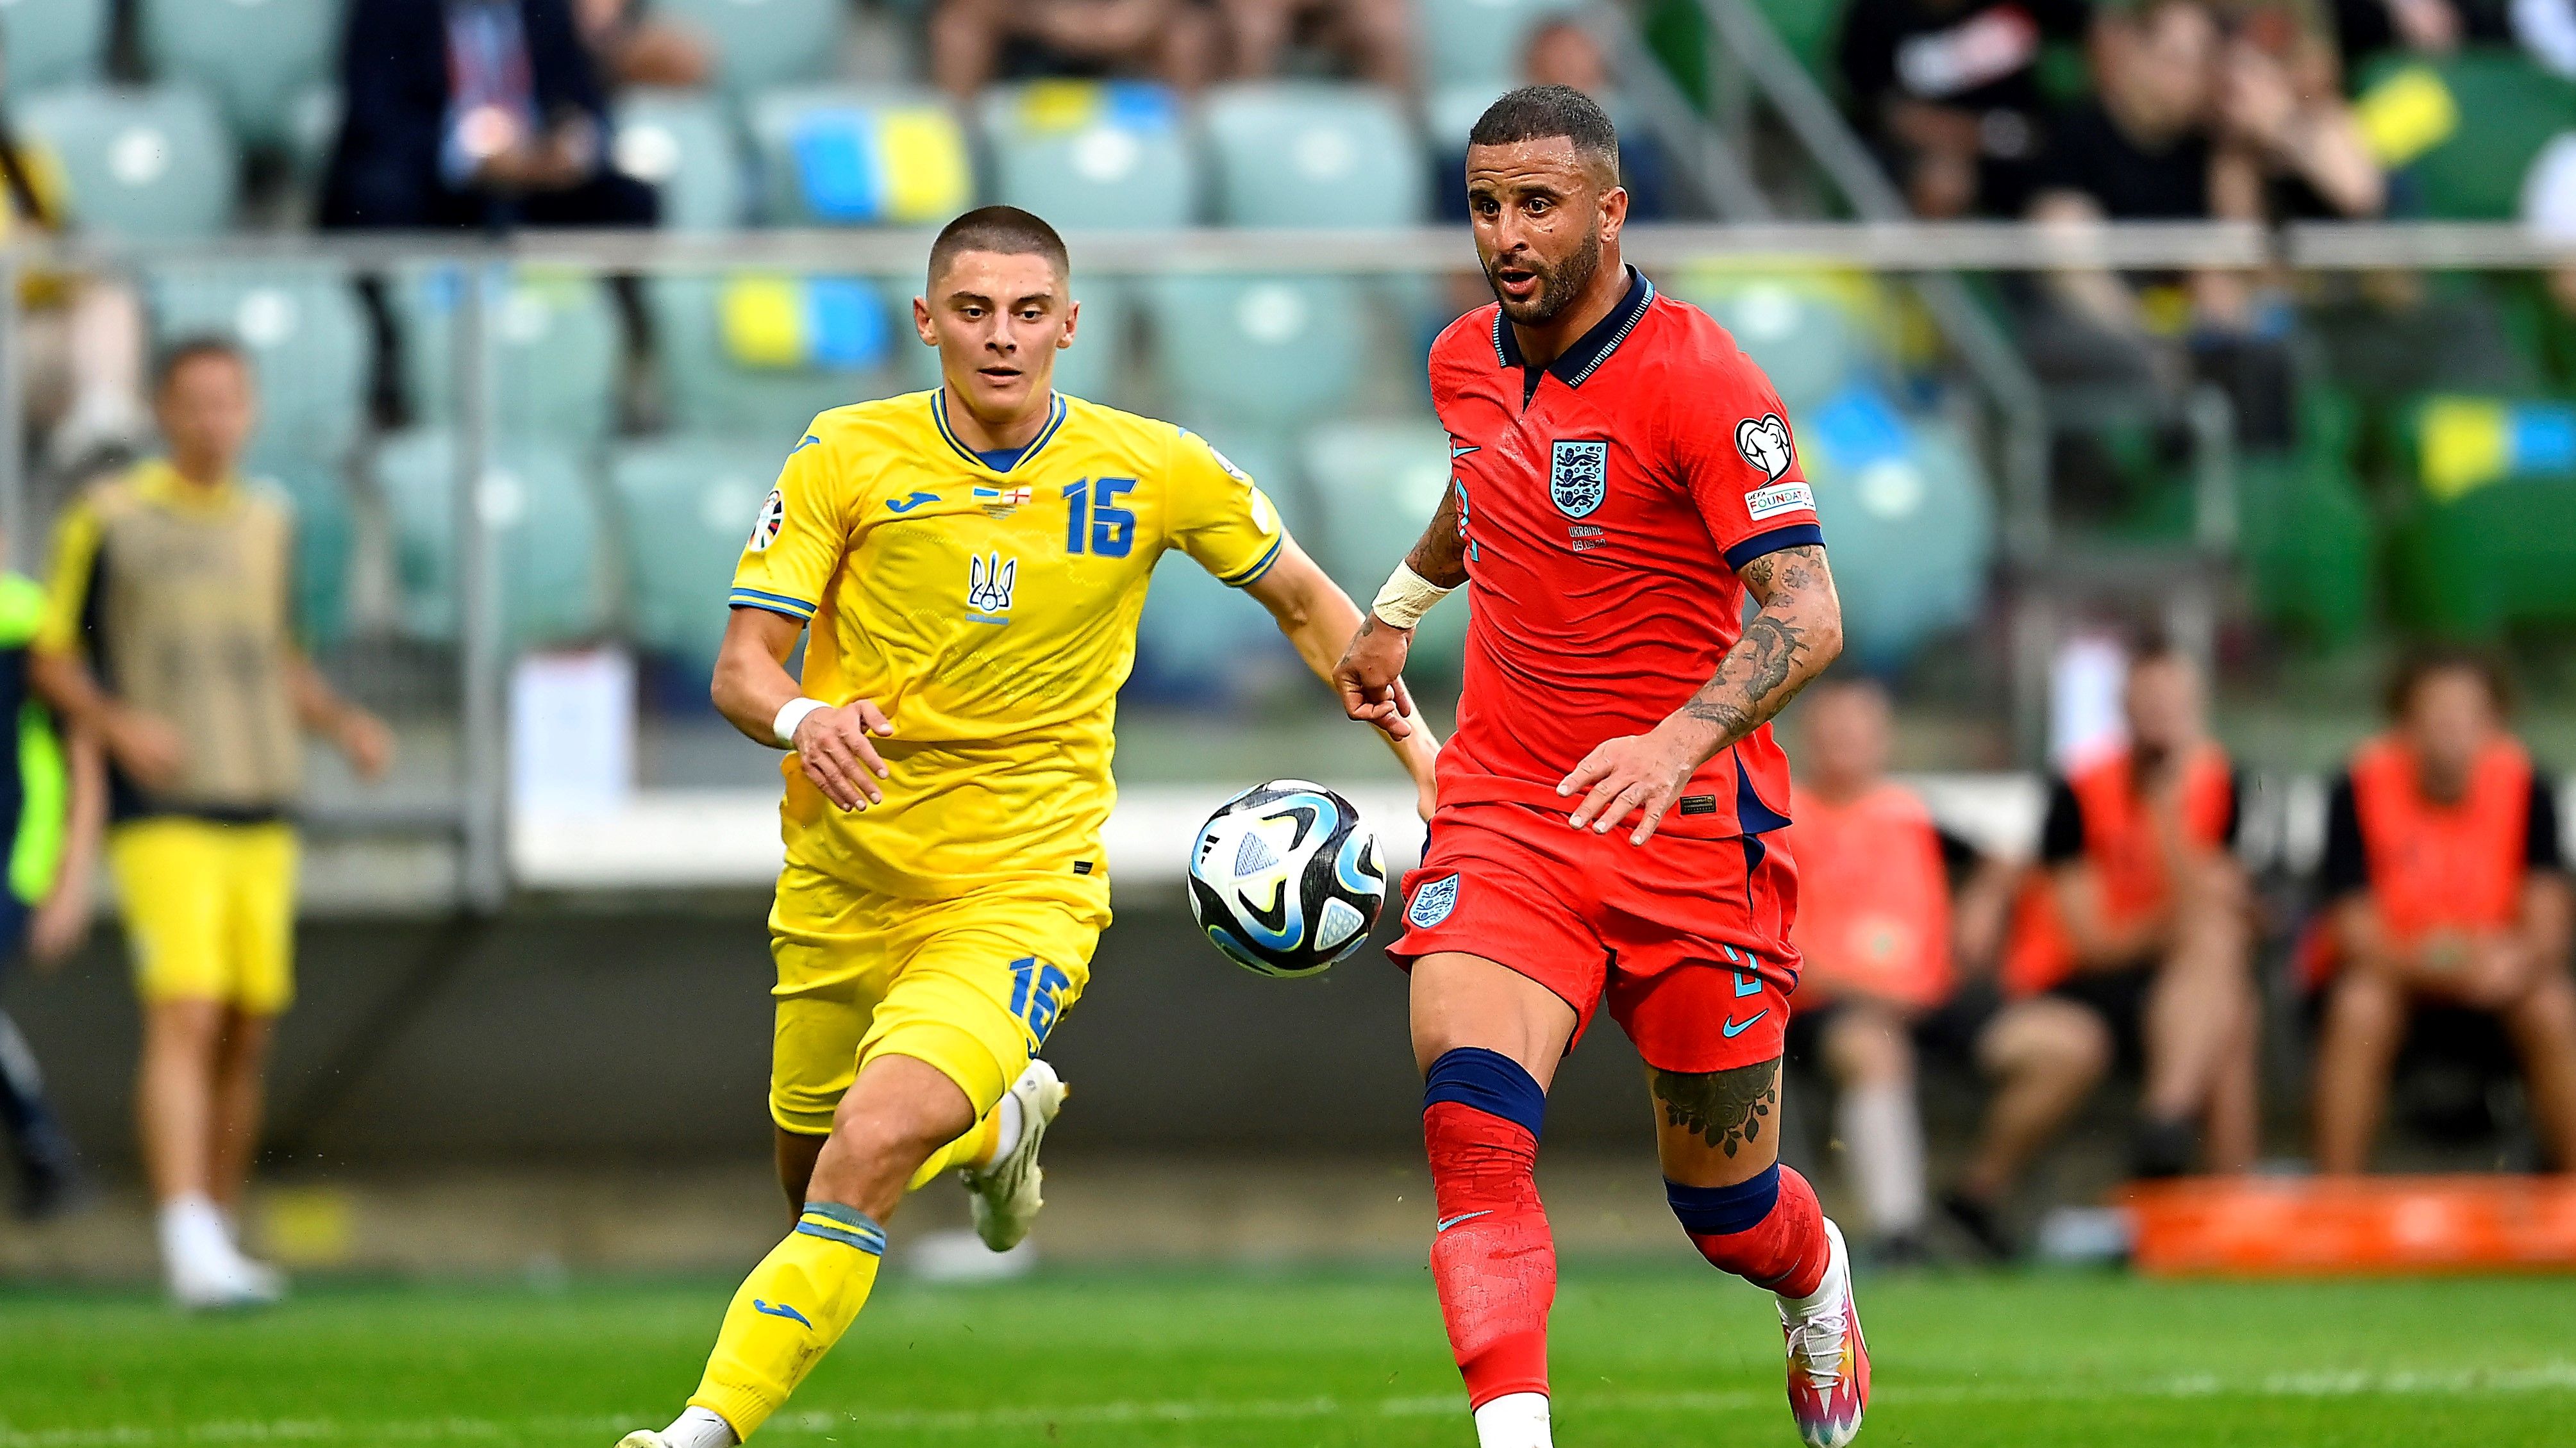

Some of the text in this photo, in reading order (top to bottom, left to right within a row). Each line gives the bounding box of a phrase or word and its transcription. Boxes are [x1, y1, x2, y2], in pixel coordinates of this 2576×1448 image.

[1748, 491, 1766, 501] UEFA
[1750, 490, 1812, 511] FOUNDAT
[1060, 476, 1139, 559] 16
[1568, 526, 1603, 537] UKRAINE
